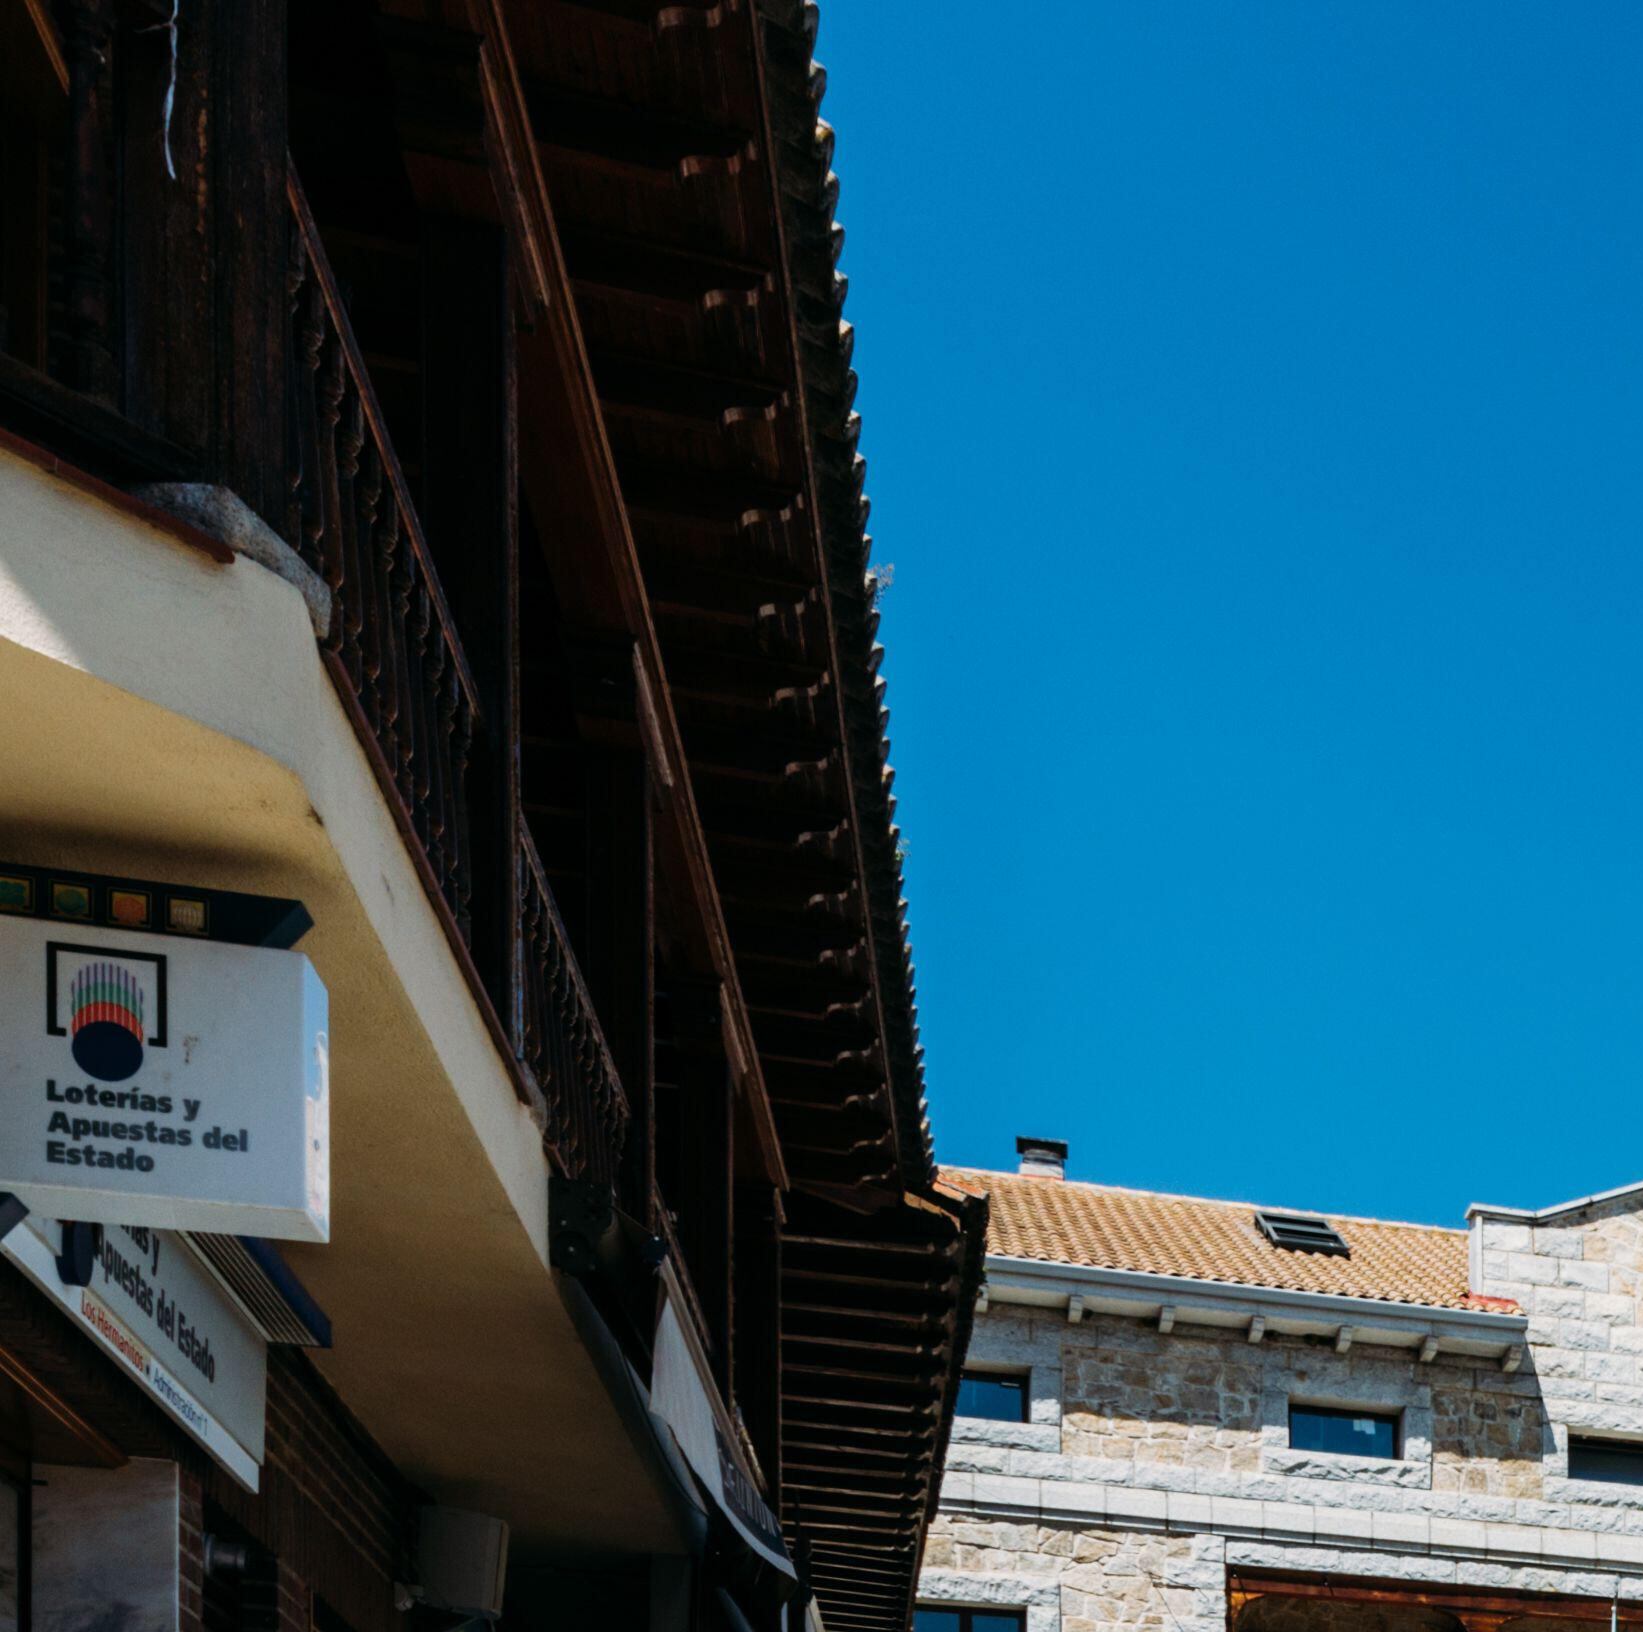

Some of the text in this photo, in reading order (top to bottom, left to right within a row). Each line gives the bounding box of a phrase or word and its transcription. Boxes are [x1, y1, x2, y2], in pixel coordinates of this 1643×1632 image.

[46, 1079, 201, 1122] Loterías y
[47, 1111, 248, 1152] Apuestas del
[46, 1140, 155, 1172] Estado
[156, 1288, 174, 1342] del
[178, 1310, 215, 1384] Estado
